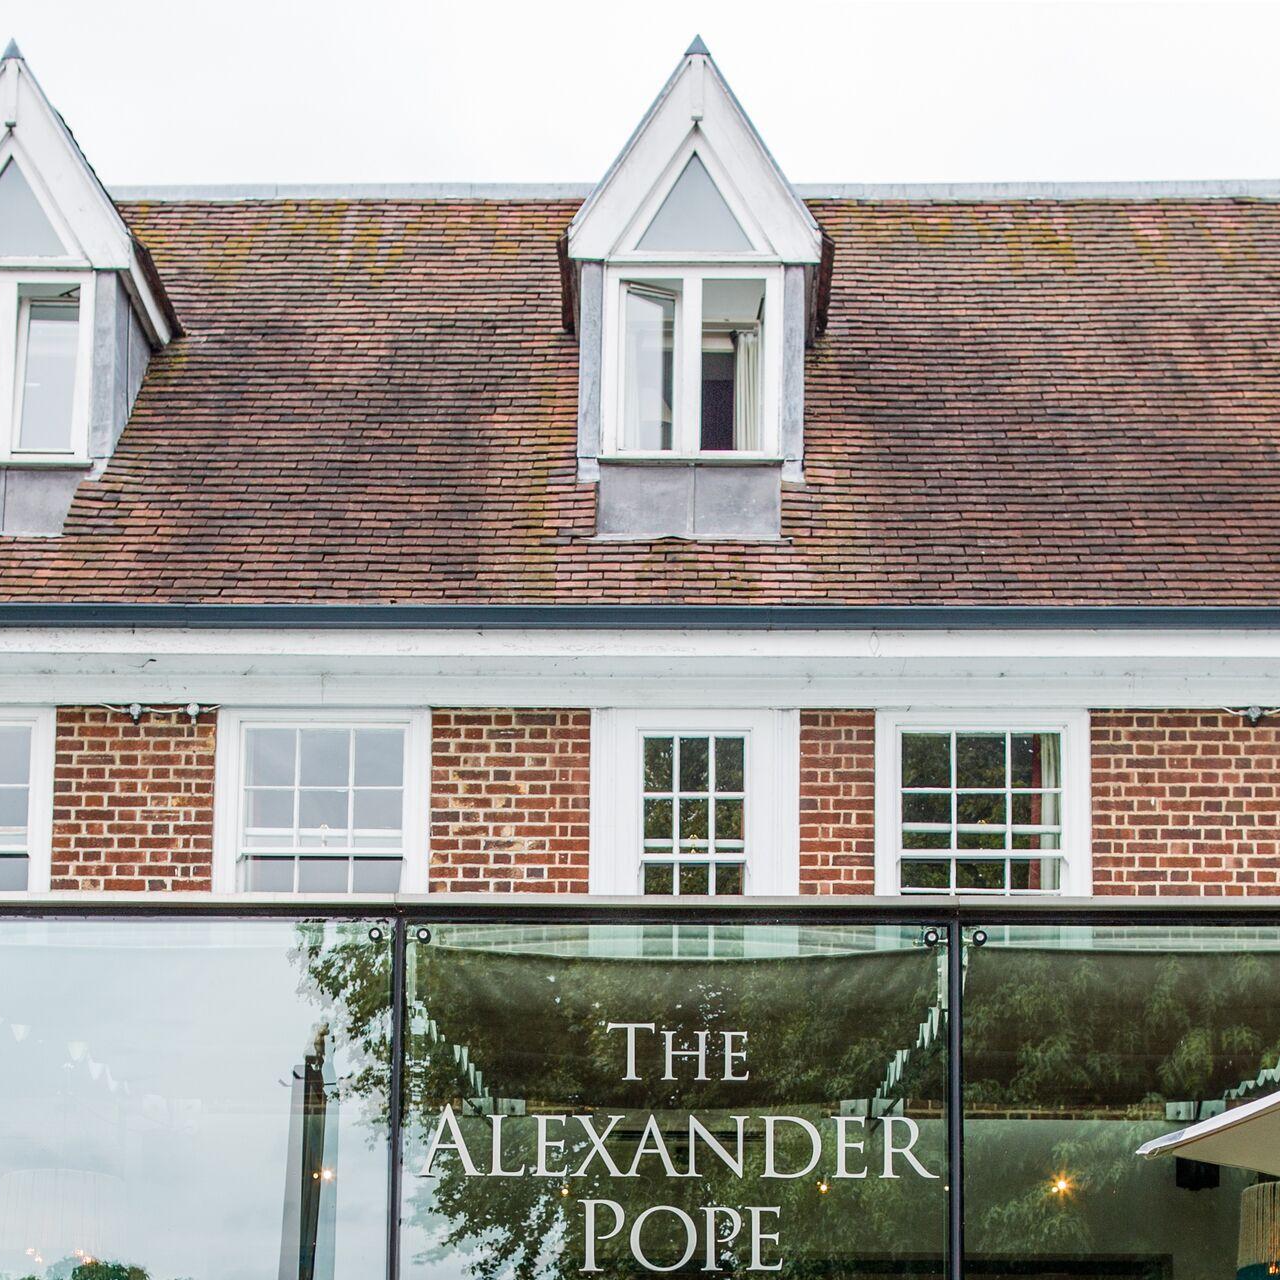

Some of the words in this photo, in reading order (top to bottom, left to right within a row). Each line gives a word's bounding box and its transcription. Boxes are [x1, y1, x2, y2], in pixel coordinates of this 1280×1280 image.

[606, 1022, 750, 1082] THE
[419, 1103, 940, 1180] ALEXANDER
[577, 1199, 784, 1273] POPE
